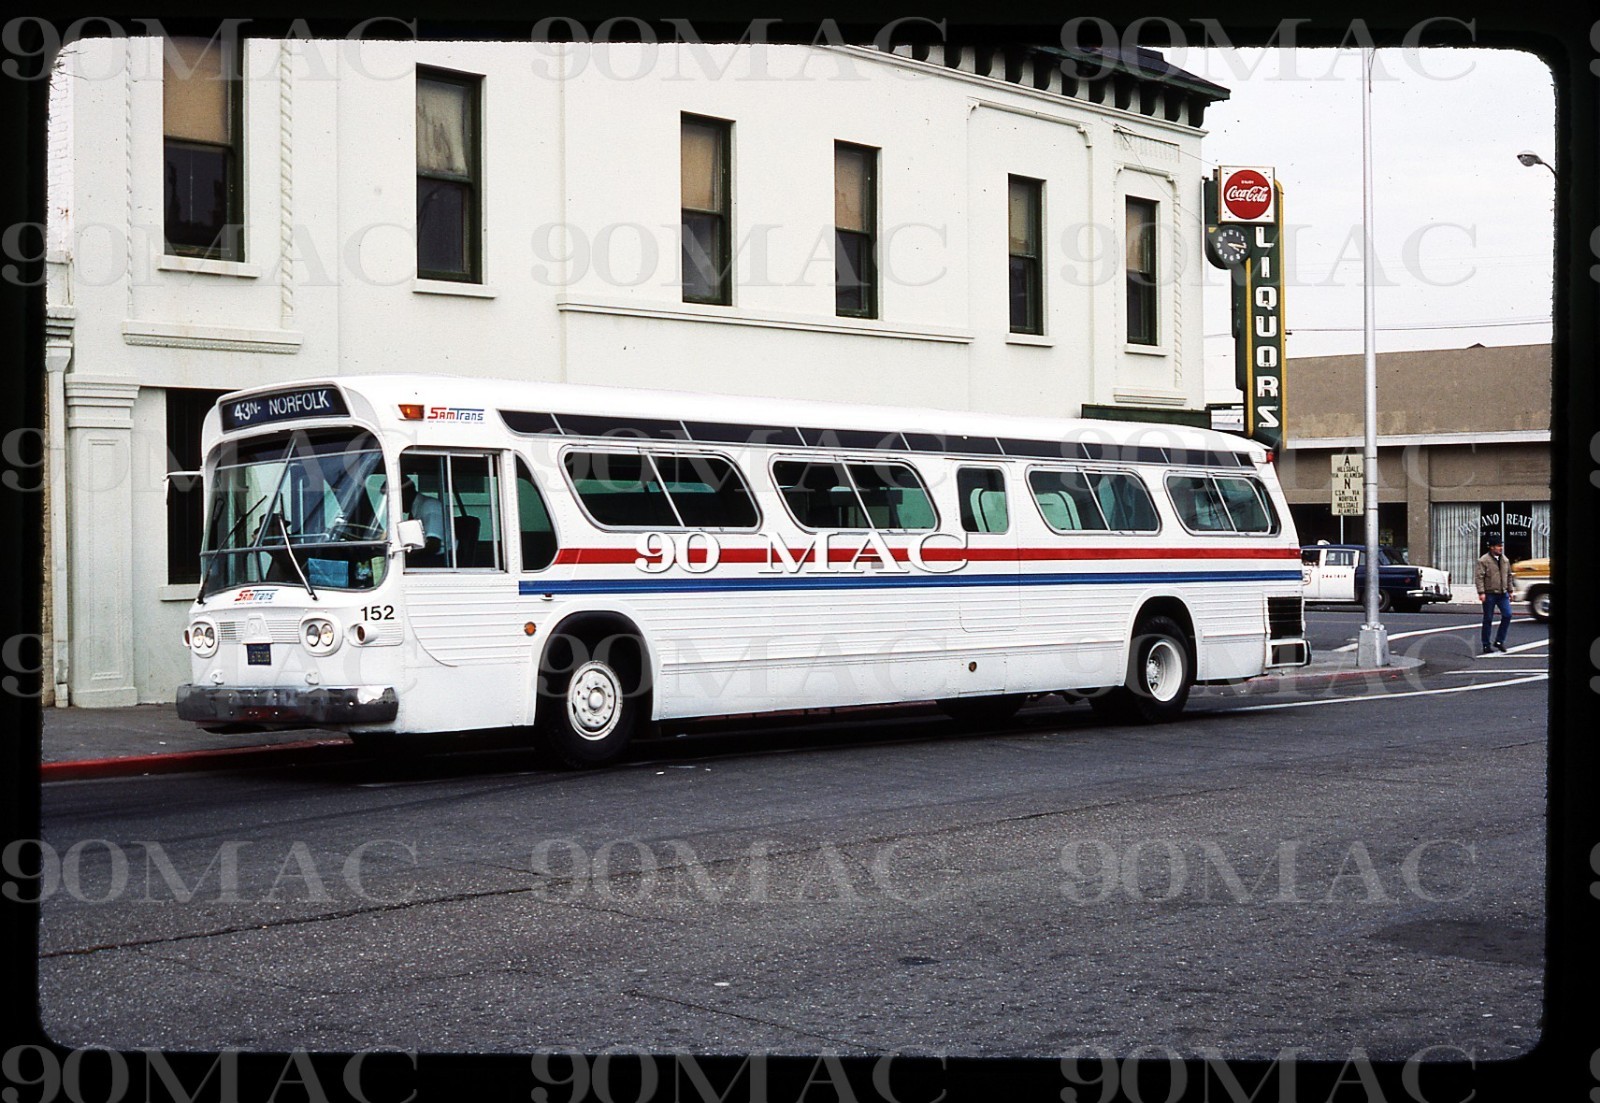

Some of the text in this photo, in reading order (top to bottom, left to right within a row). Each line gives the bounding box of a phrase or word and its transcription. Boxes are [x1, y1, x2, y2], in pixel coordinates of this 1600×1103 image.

[1255, 226, 1279, 428] LIQUORS
[269, 390, 330, 416] NORFOLK
[1344, 455, 1351, 466] A
[1344, 479, 1351, 489] N
[361, 605, 395, 621] 152
